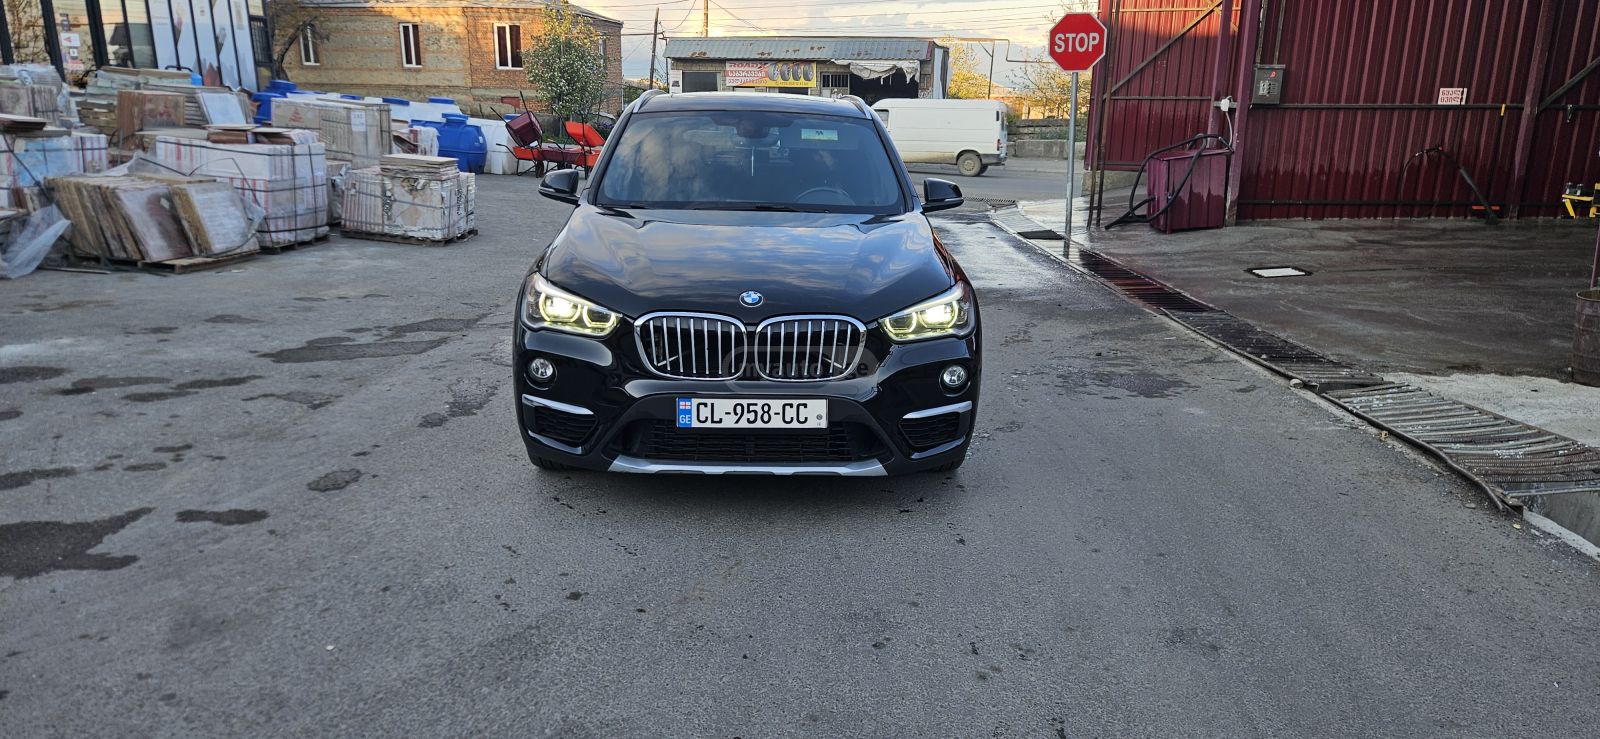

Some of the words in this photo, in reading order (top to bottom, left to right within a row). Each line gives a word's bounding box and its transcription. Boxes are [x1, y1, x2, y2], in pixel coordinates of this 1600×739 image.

[1054, 32, 1100, 53] STOP
[679, 415, 691, 424] GE
[696, 402, 808, 425] CL-958-CC
